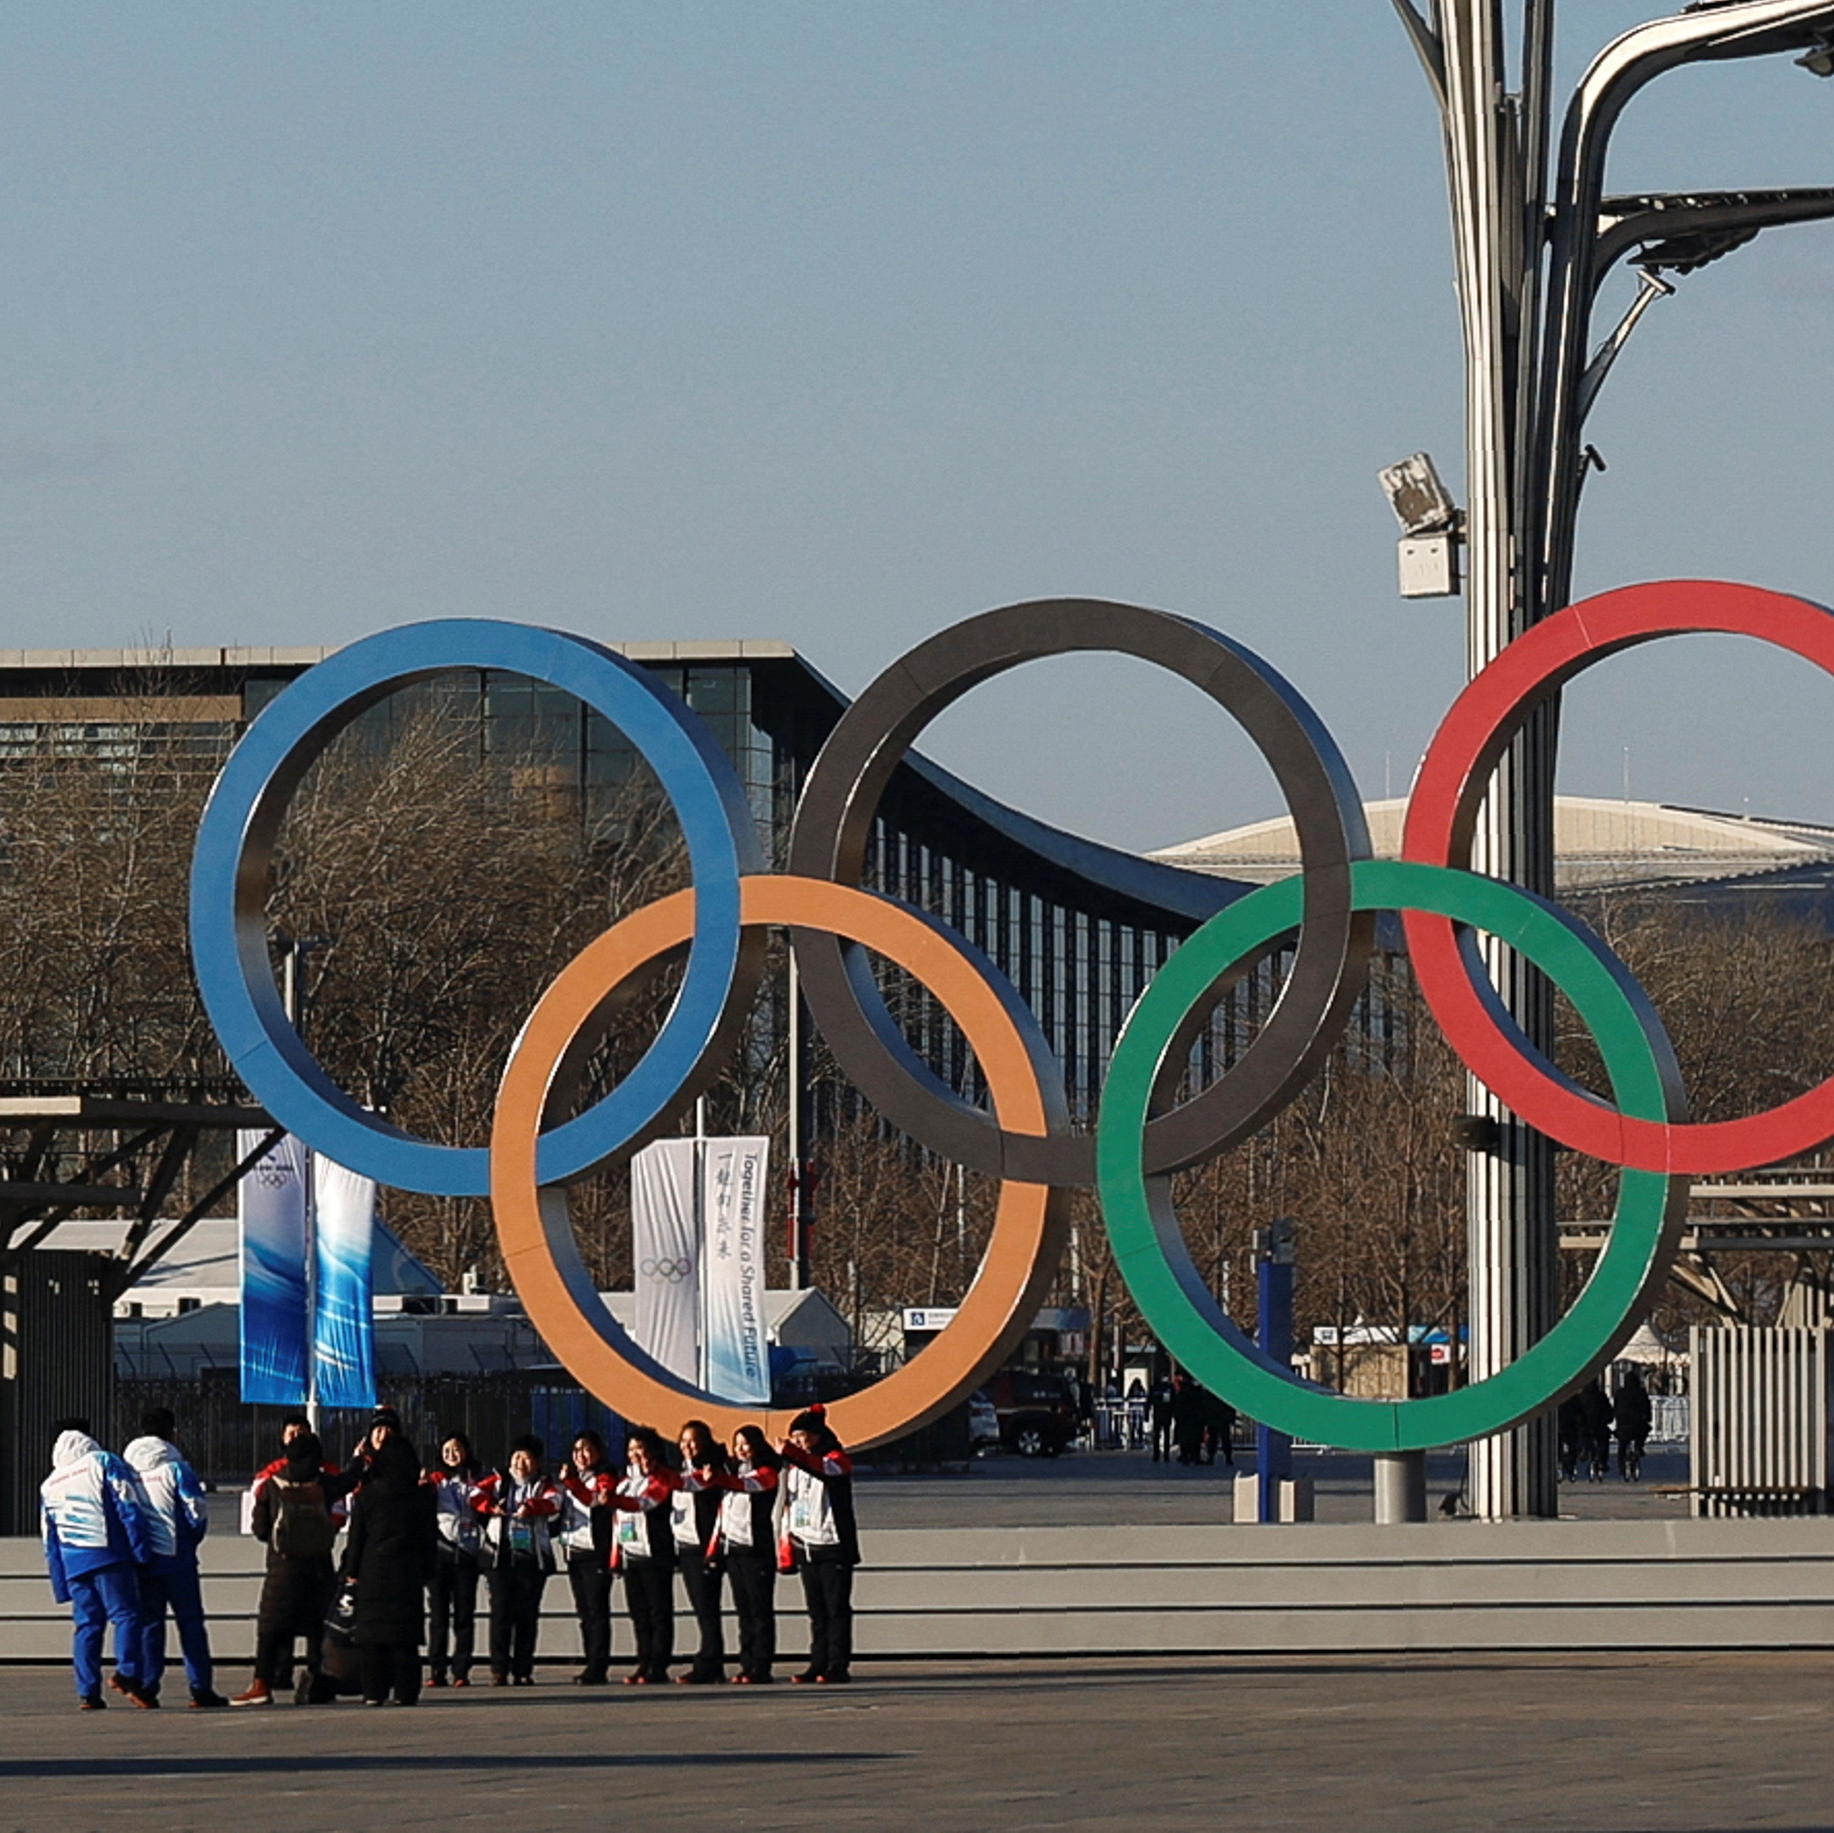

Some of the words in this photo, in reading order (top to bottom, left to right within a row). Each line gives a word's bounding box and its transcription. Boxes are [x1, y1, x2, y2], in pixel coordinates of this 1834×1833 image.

[740, 1153, 758, 1222] Together
[740, 1227, 755, 1249] for
[740, 1251, 751, 1262] a
[740, 1267, 756, 1324] Shared
[742, 1327, 758, 1378] Future
